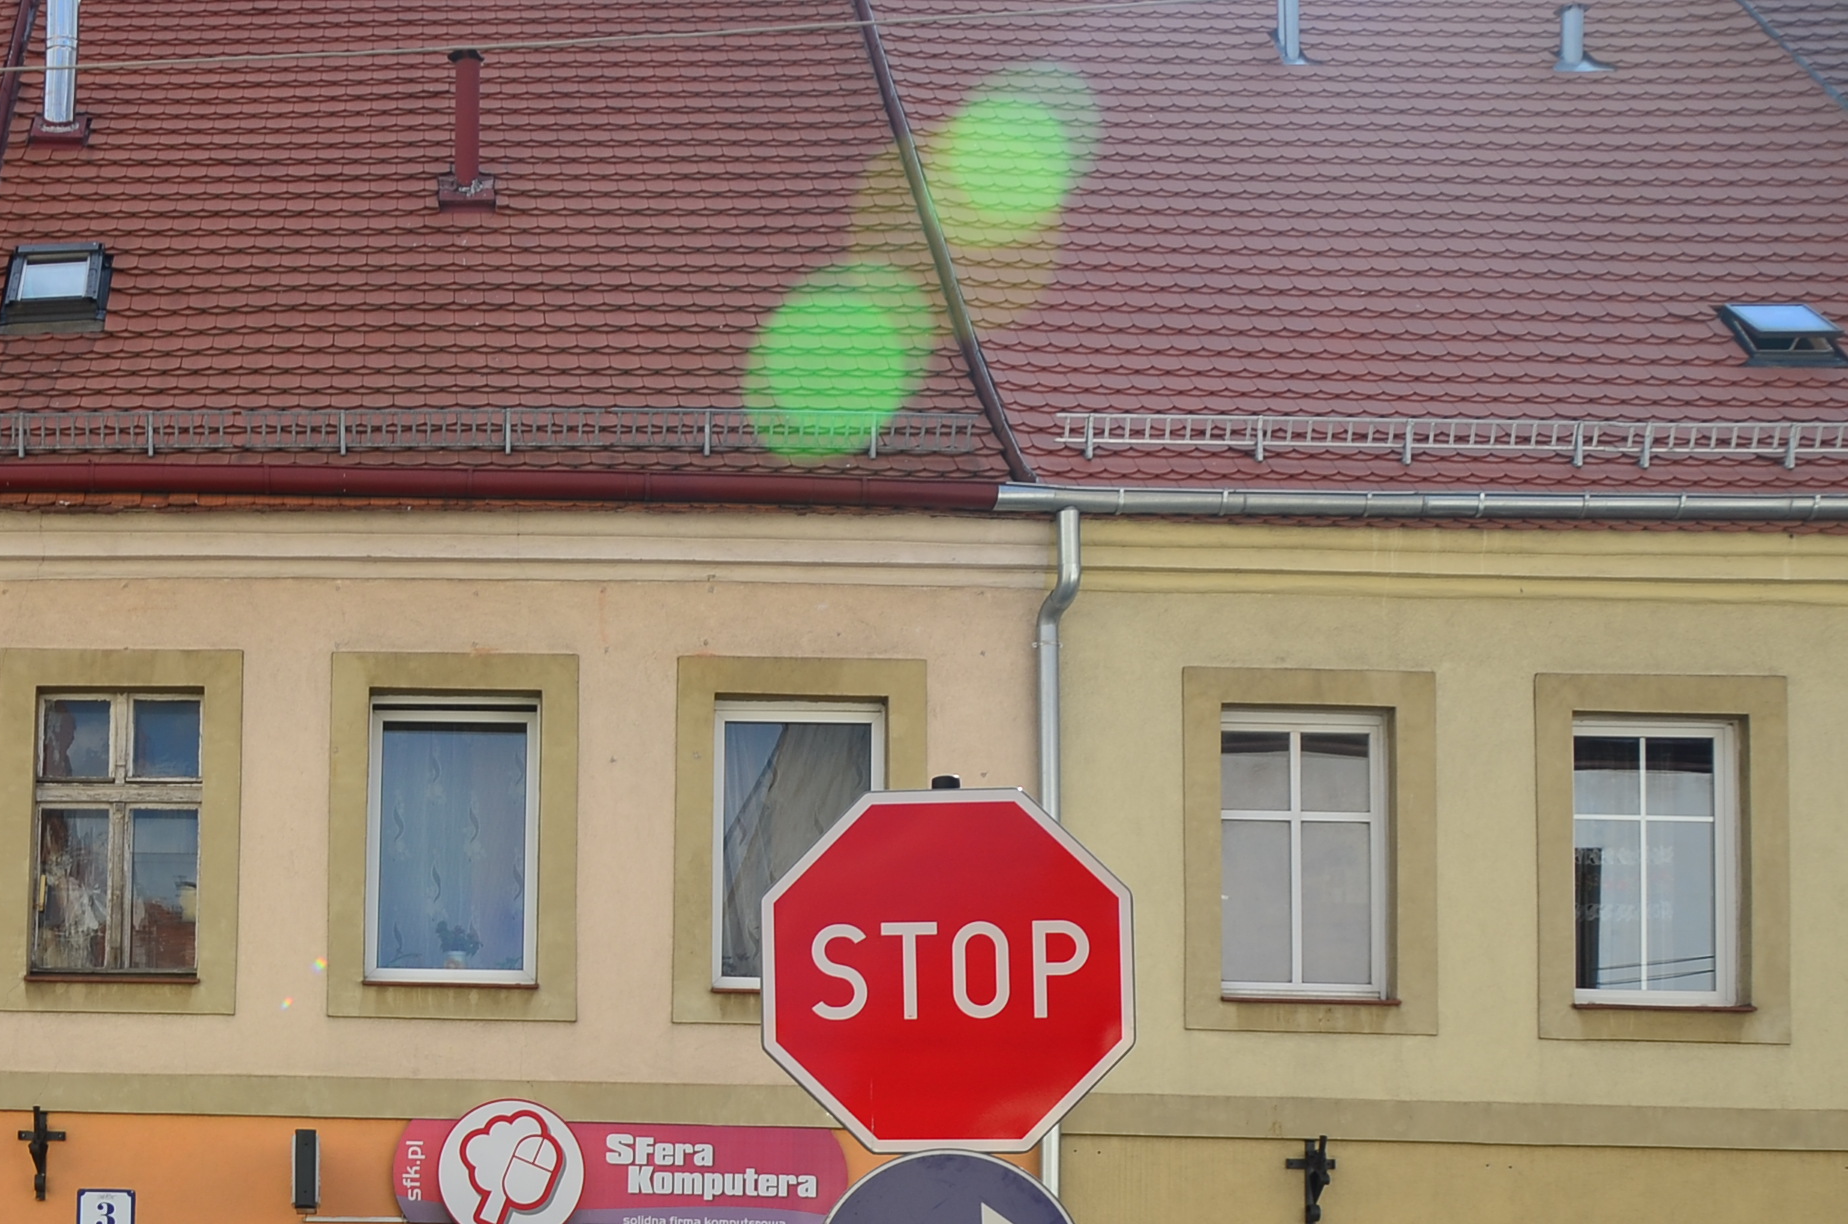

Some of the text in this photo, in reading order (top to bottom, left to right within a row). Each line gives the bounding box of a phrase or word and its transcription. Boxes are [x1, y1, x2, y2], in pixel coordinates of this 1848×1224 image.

[811, 919, 1090, 1020] STOP
[402, 1140, 424, 1201] sfk.pl
[627, 1166, 817, 1201] Komputera
